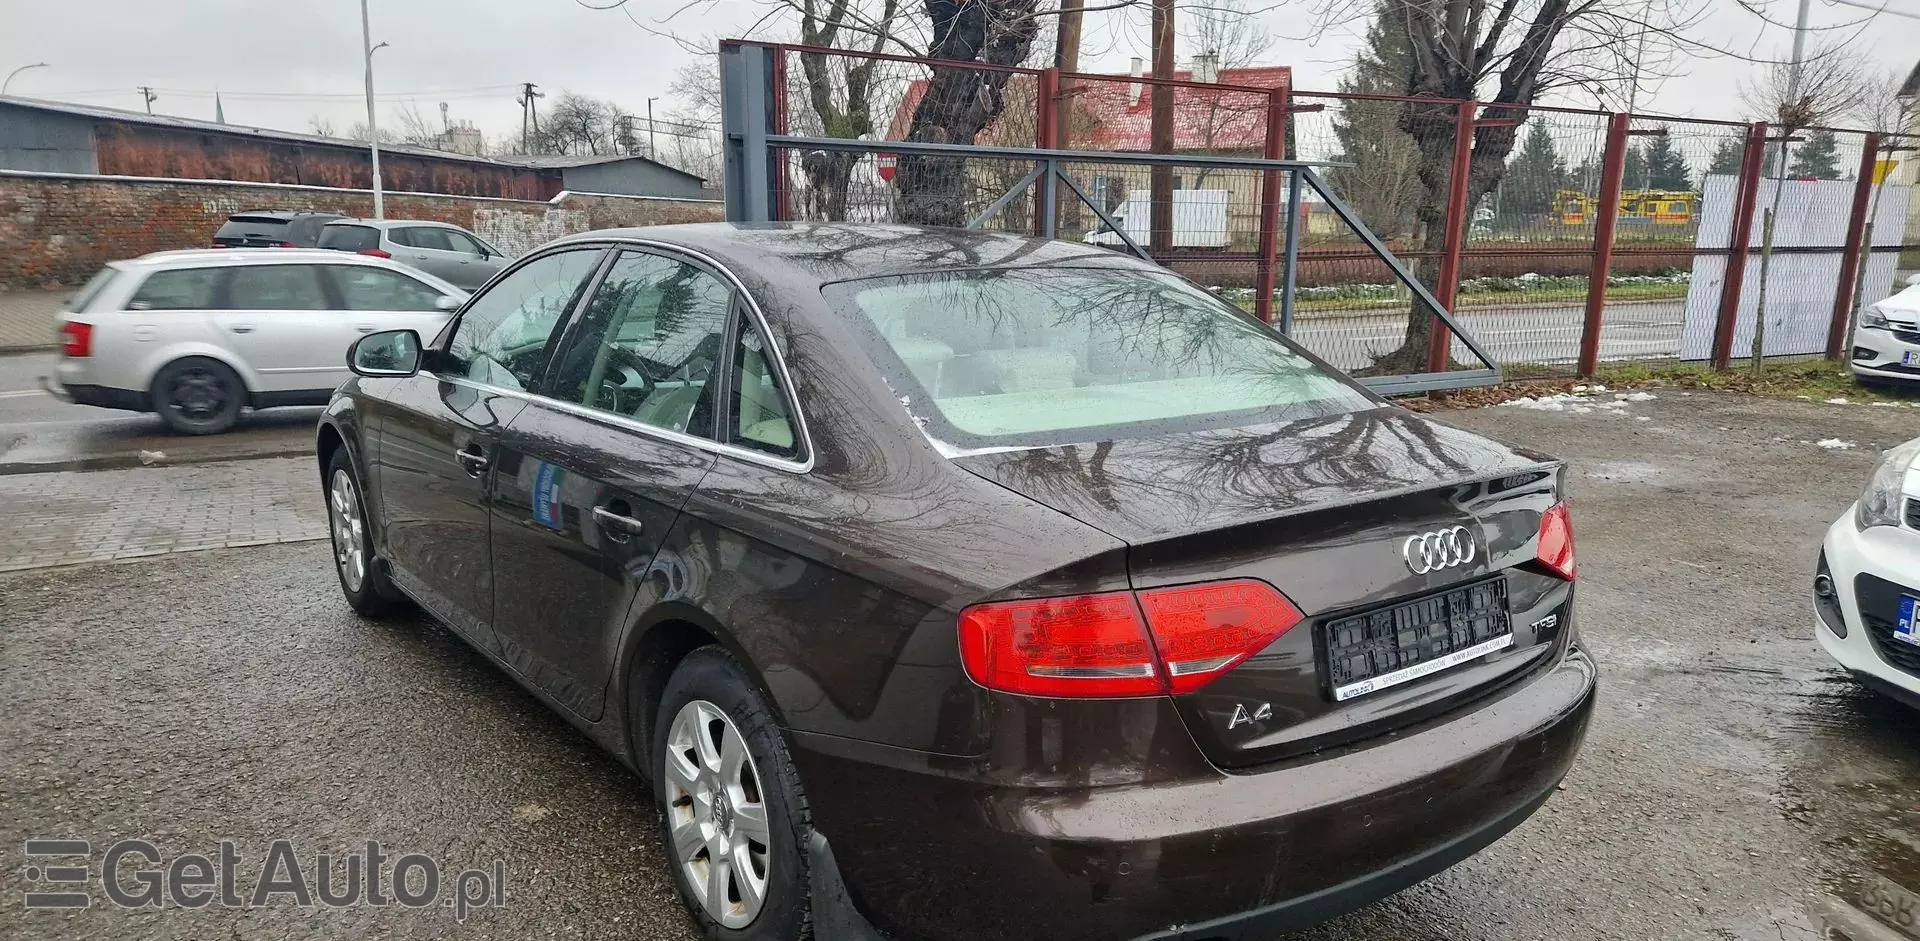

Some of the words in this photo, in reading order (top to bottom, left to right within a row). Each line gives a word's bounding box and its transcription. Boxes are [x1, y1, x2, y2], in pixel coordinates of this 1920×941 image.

[1530, 614, 1557, 633] TFSI
[1899, 618, 1910, 629] PL
[1228, 703, 1273, 730] A4
